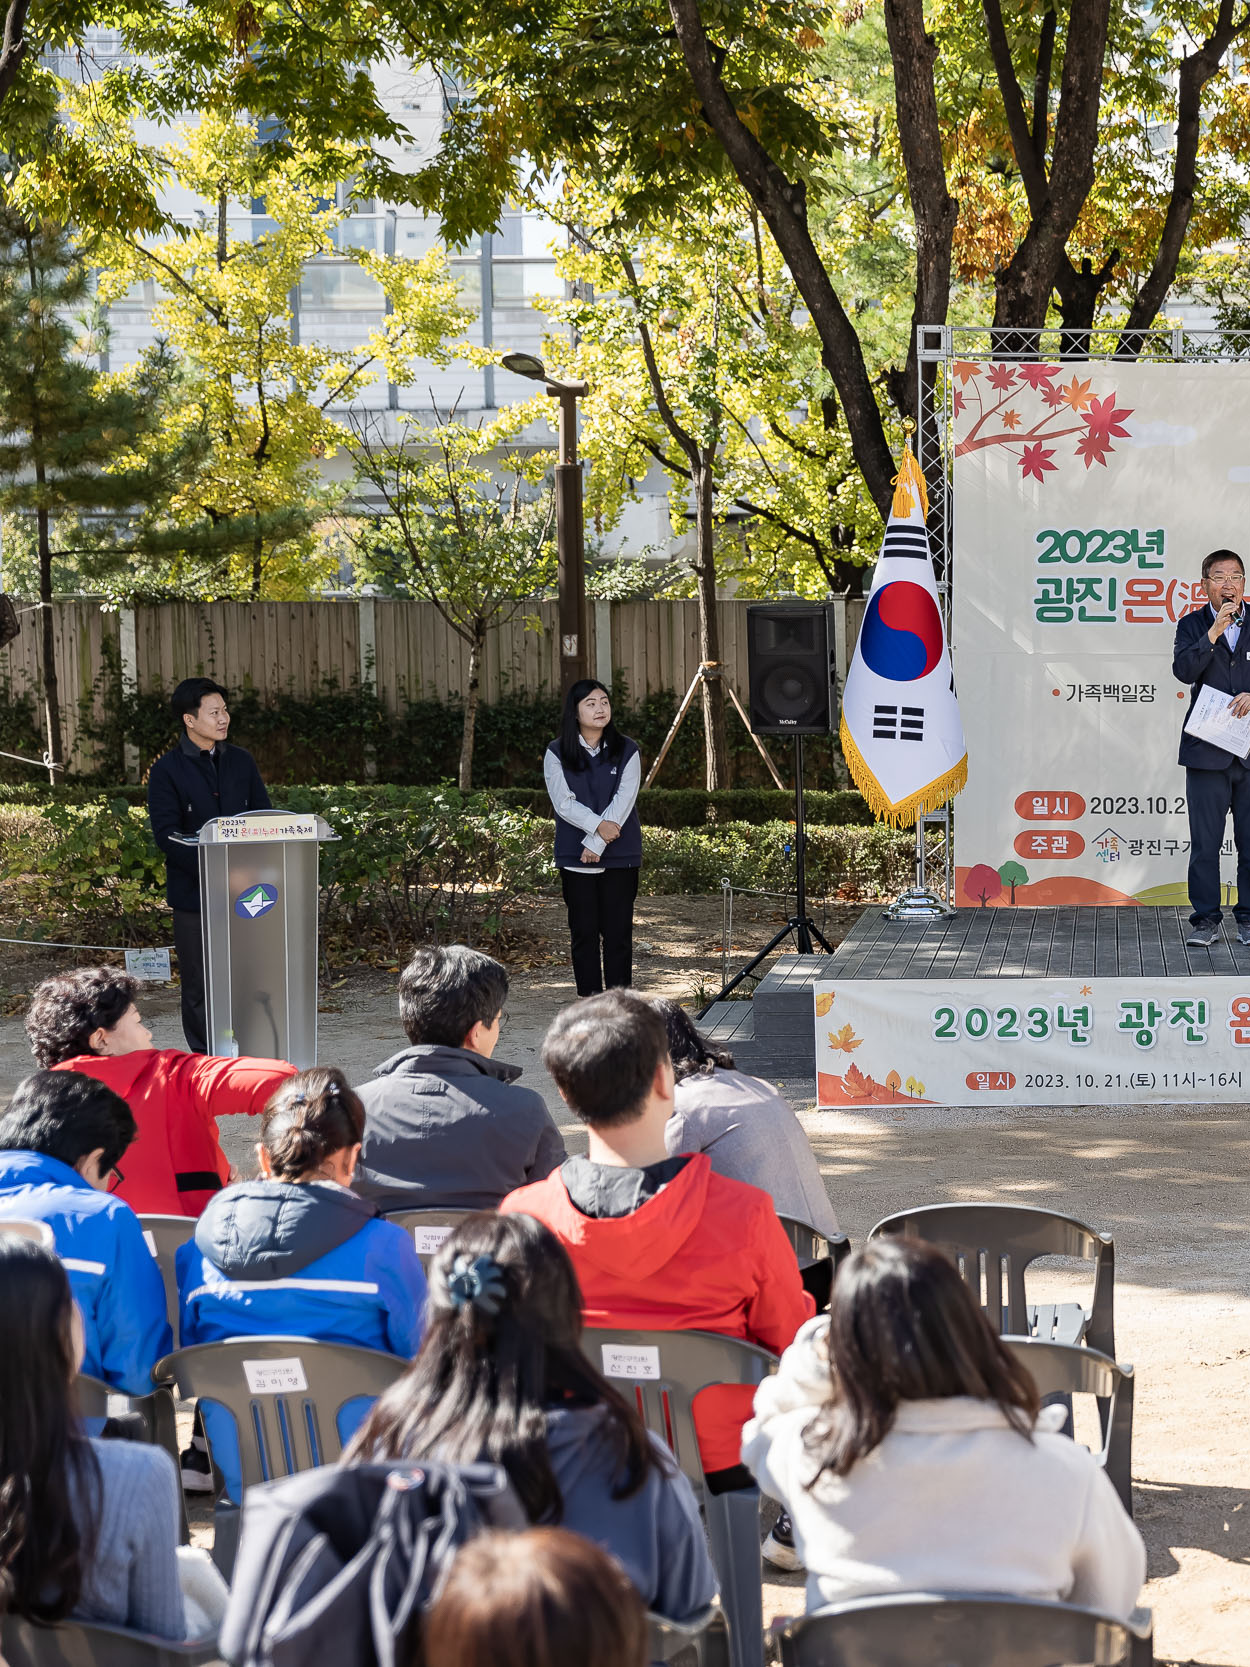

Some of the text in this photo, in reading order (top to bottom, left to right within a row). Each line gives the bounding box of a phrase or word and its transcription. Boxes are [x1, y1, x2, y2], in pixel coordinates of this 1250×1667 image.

[1036, 529, 1165, 569] 2023년
[1034, 577, 1117, 623] 광진
[1066, 684, 1157, 703] 가족백일장
[1031, 796, 1069, 815] 일시
[221, 819, 246, 827] 2023년
[221, 827, 238, 838] 광진
[279, 825, 313, 835] 가족축제
[1030, 835, 1070, 855] 주관
[934, 1005, 1090, 1043] 2023년
[1118, 1000, 1206, 1047] 광진
[976, 1072, 1011, 1090] 일시
[1104, 1072, 1156, 1090] 21.(토)
[1162, 1071, 1242, 1088] 11시~16시
